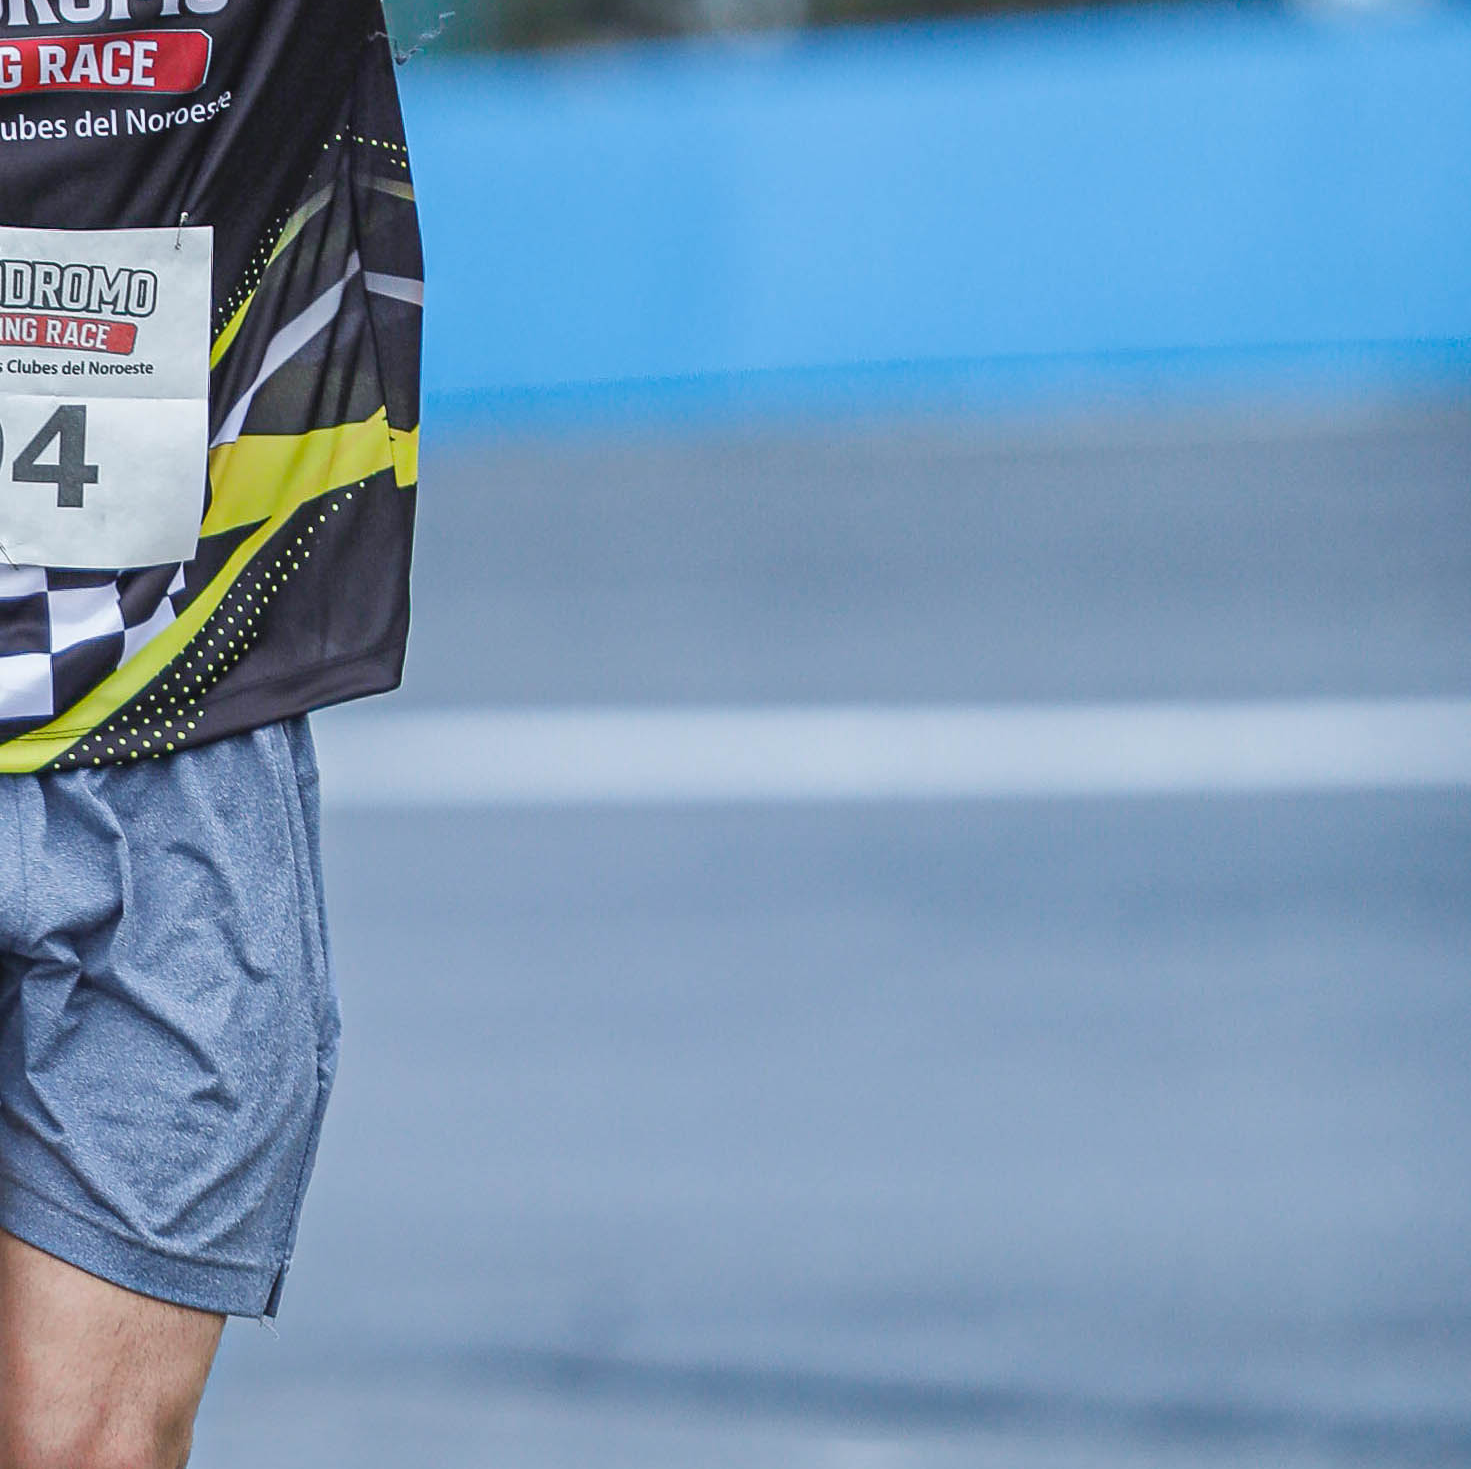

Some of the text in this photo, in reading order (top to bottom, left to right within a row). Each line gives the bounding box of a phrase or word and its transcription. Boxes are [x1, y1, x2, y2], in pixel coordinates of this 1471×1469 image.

[37, 39, 158, 89] RACE
[74, 109, 118, 138] del
[45, 319, 112, 350] RACE
[7, 358, 58, 375] Clubes
[61, 359, 85, 375] del
[88, 361, 154, 375] Noroeste
